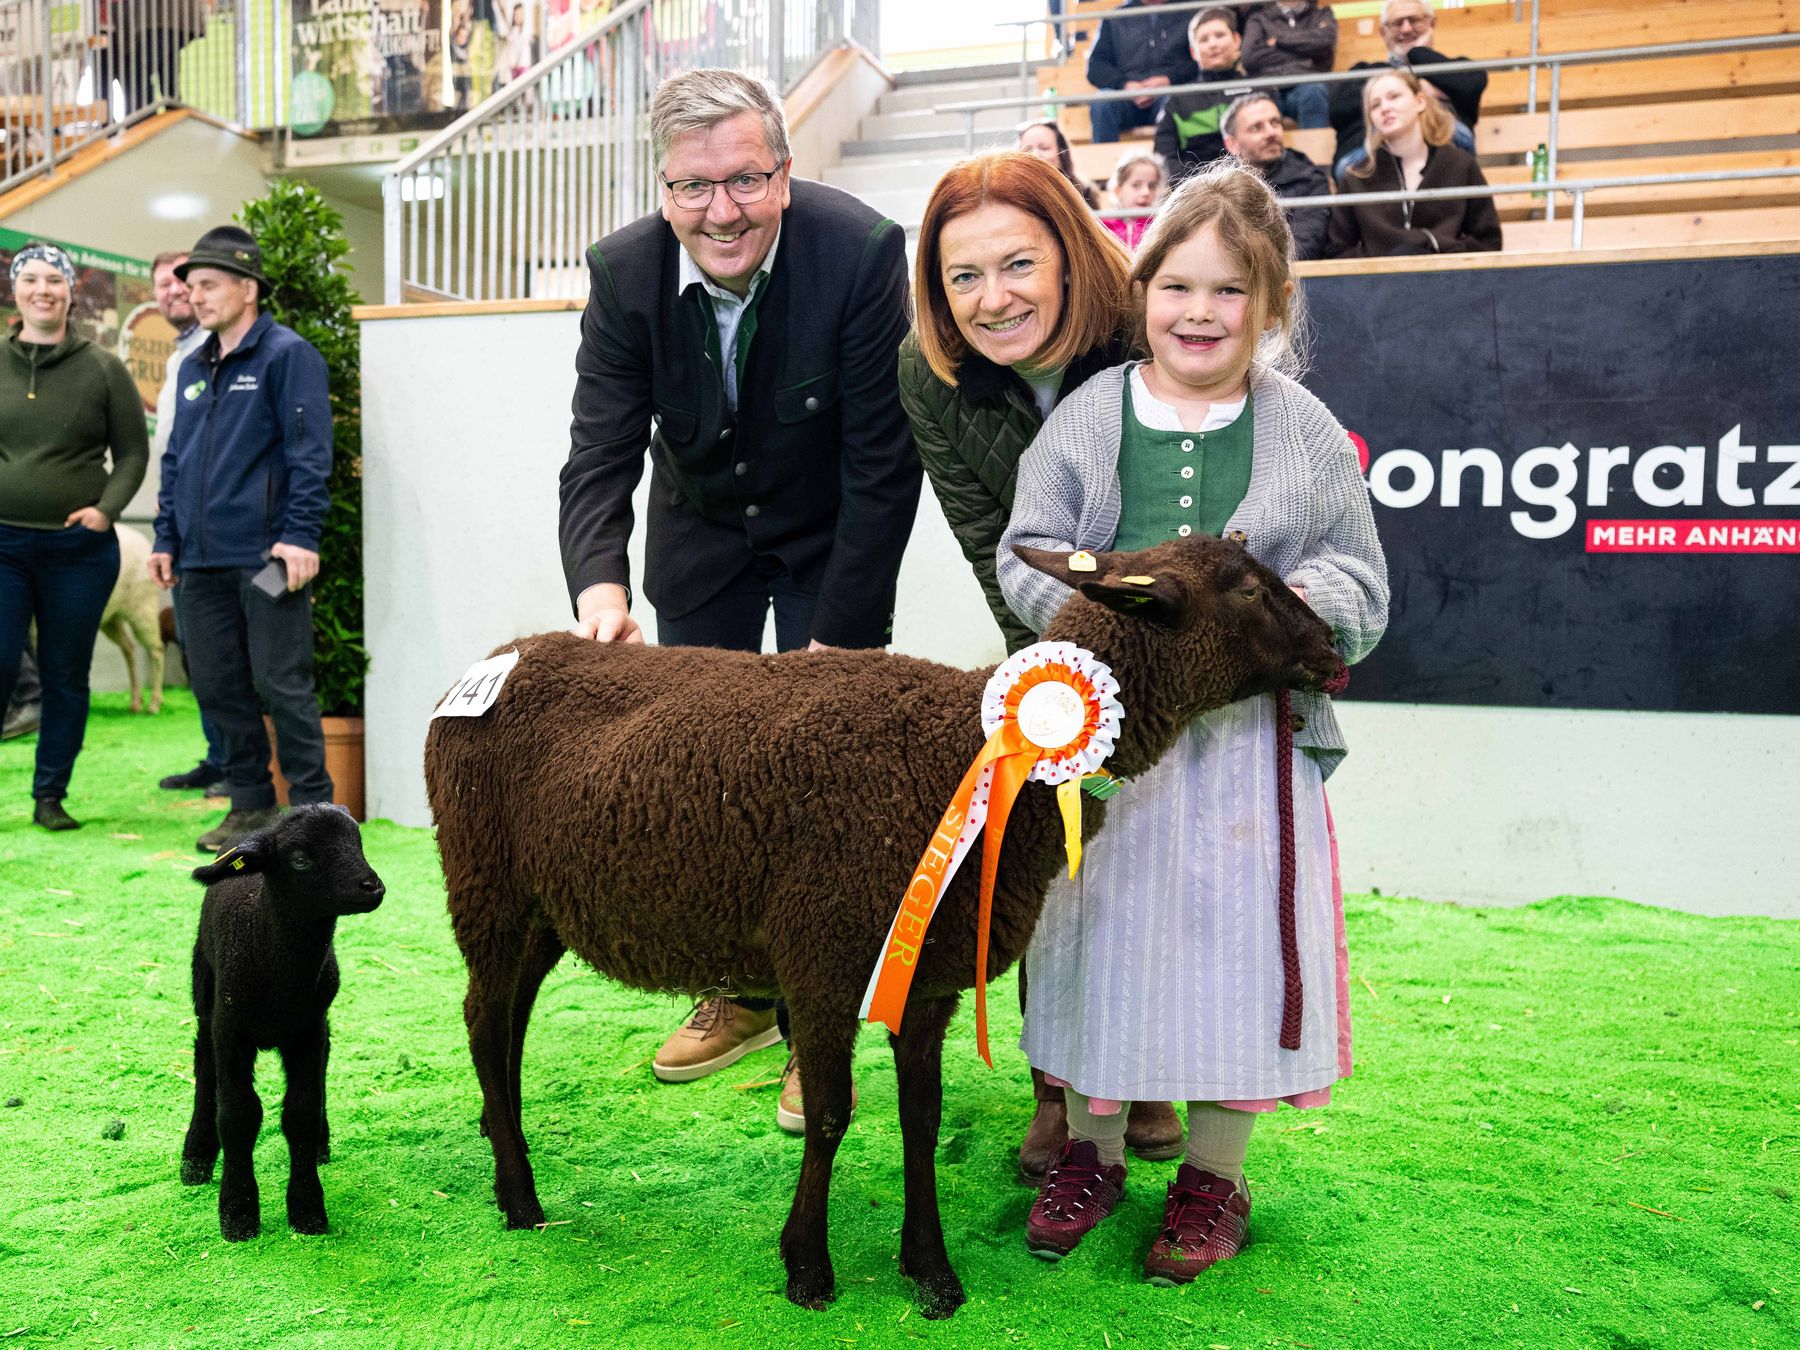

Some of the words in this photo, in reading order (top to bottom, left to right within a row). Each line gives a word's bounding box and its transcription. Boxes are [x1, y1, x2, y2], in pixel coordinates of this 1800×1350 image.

[297, 6, 420, 46] wirtschaft
[1346, 423, 1800, 540] ongratz
[1593, 526, 1677, 547] MEHR
[1684, 525, 1800, 547] ANHÄN
[448, 671, 503, 706] 141
[886, 804, 965, 968] SIEGER
